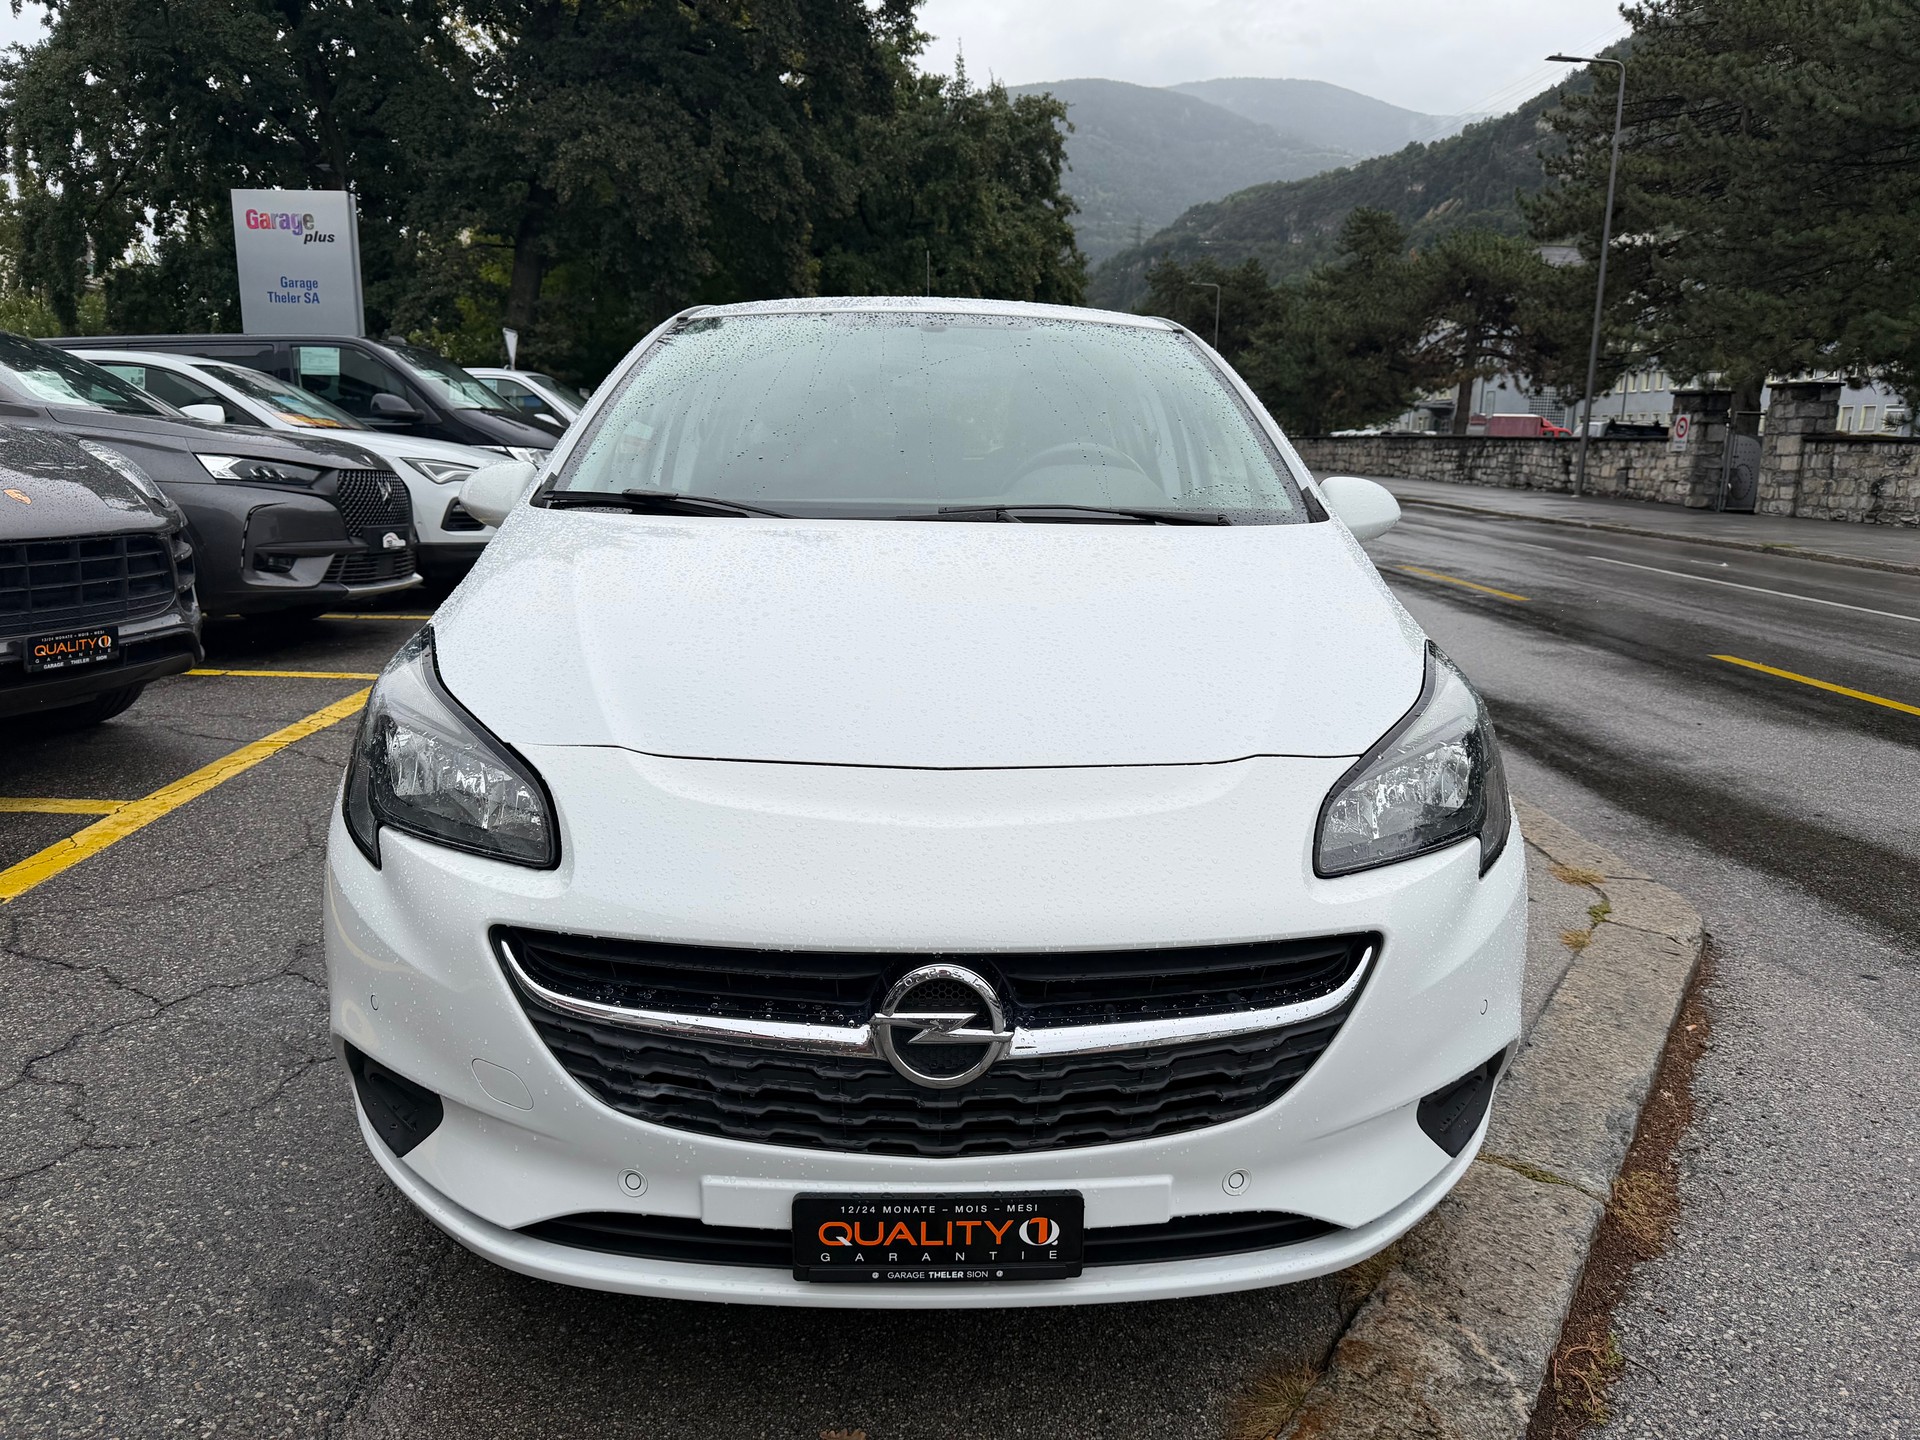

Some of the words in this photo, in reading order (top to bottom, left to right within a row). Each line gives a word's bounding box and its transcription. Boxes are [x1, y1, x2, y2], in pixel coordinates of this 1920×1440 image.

[245, 208, 315, 236] Garage
[303, 231, 335, 245] plus
[280, 276, 318, 291] Garage
[267, 291, 301, 304] Theler
[304, 292, 320, 304] SA
[34, 637, 97, 657] QUALITY
[840, 1205, 876, 1214] 12/24
[883, 1205, 936, 1213] MONATE
[955, 1204, 988, 1213] MOIS
[1006, 1204, 1038, 1212] MESI
[818, 1219, 1014, 1246] QUALITY
[820, 1250, 1057, 1262] GARANTIE
[887, 1271, 925, 1280] GARAGE
[928, 1270, 964, 1279] THELER
[966, 1270, 989, 1279] SION
